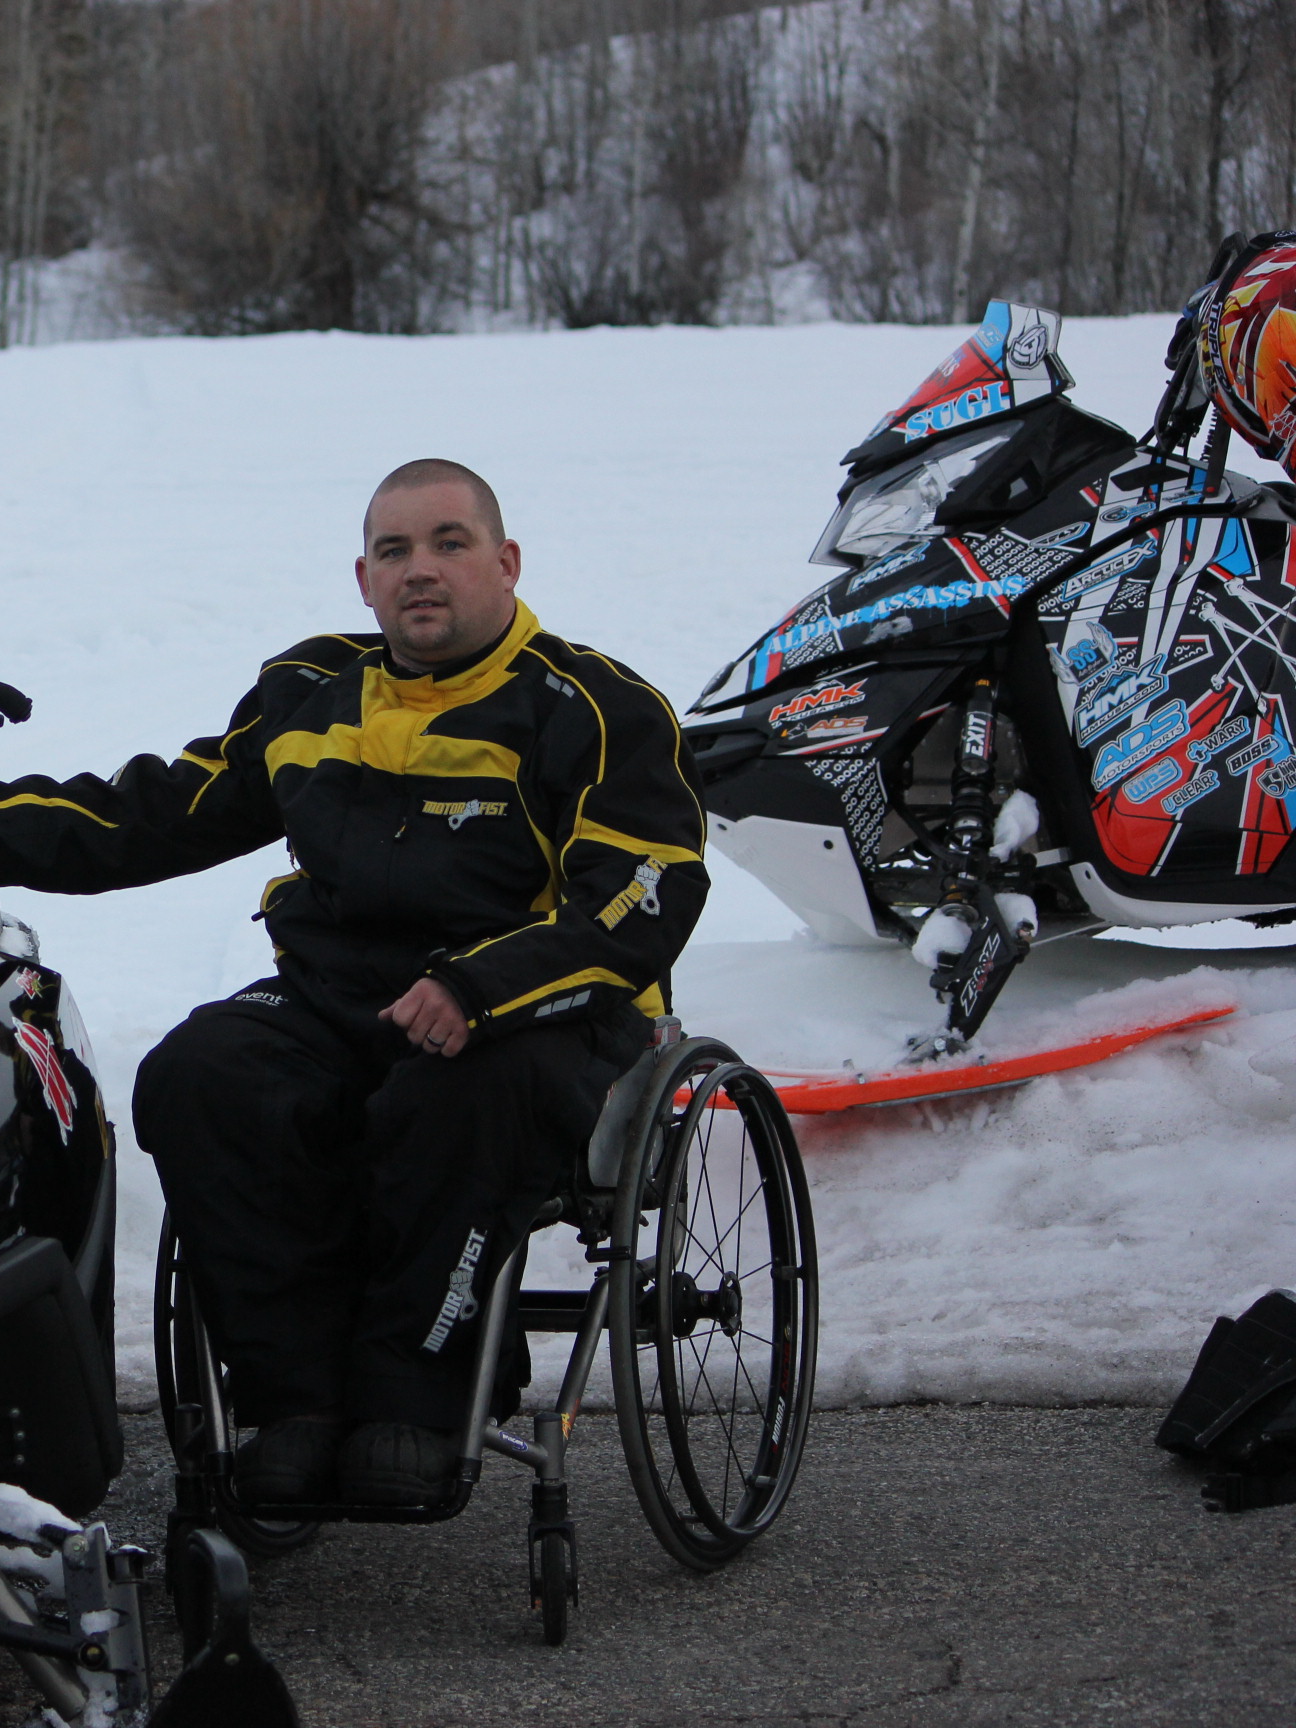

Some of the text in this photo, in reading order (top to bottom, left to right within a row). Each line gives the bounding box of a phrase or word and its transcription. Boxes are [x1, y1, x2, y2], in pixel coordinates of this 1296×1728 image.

[905, 381, 1004, 438] SUGI
[766, 606, 861, 655] ALPINE
[870, 575, 1026, 618] ASSASSINS
[1068, 641, 1098, 670] SS
[769, 678, 869, 723] HMK
[1079, 661, 1156, 730] HMK
[1081, 680, 1161, 739] HMKUSA.COM
[808, 716, 868, 732] ADS
[965, 714, 988, 757] EXIT
[1095, 701, 1184, 780] ADS
[1096, 724, 1184, 789] MOTORSPORTS
[1231, 738, 1273, 771] BOSS
[422, 800, 507, 816] MOTOR FIST
[1163, 776, 1215, 812] UCLEAR
[595, 880, 647, 931] MOTOR
[421, 1227, 486, 1352] MOTOR FIST
